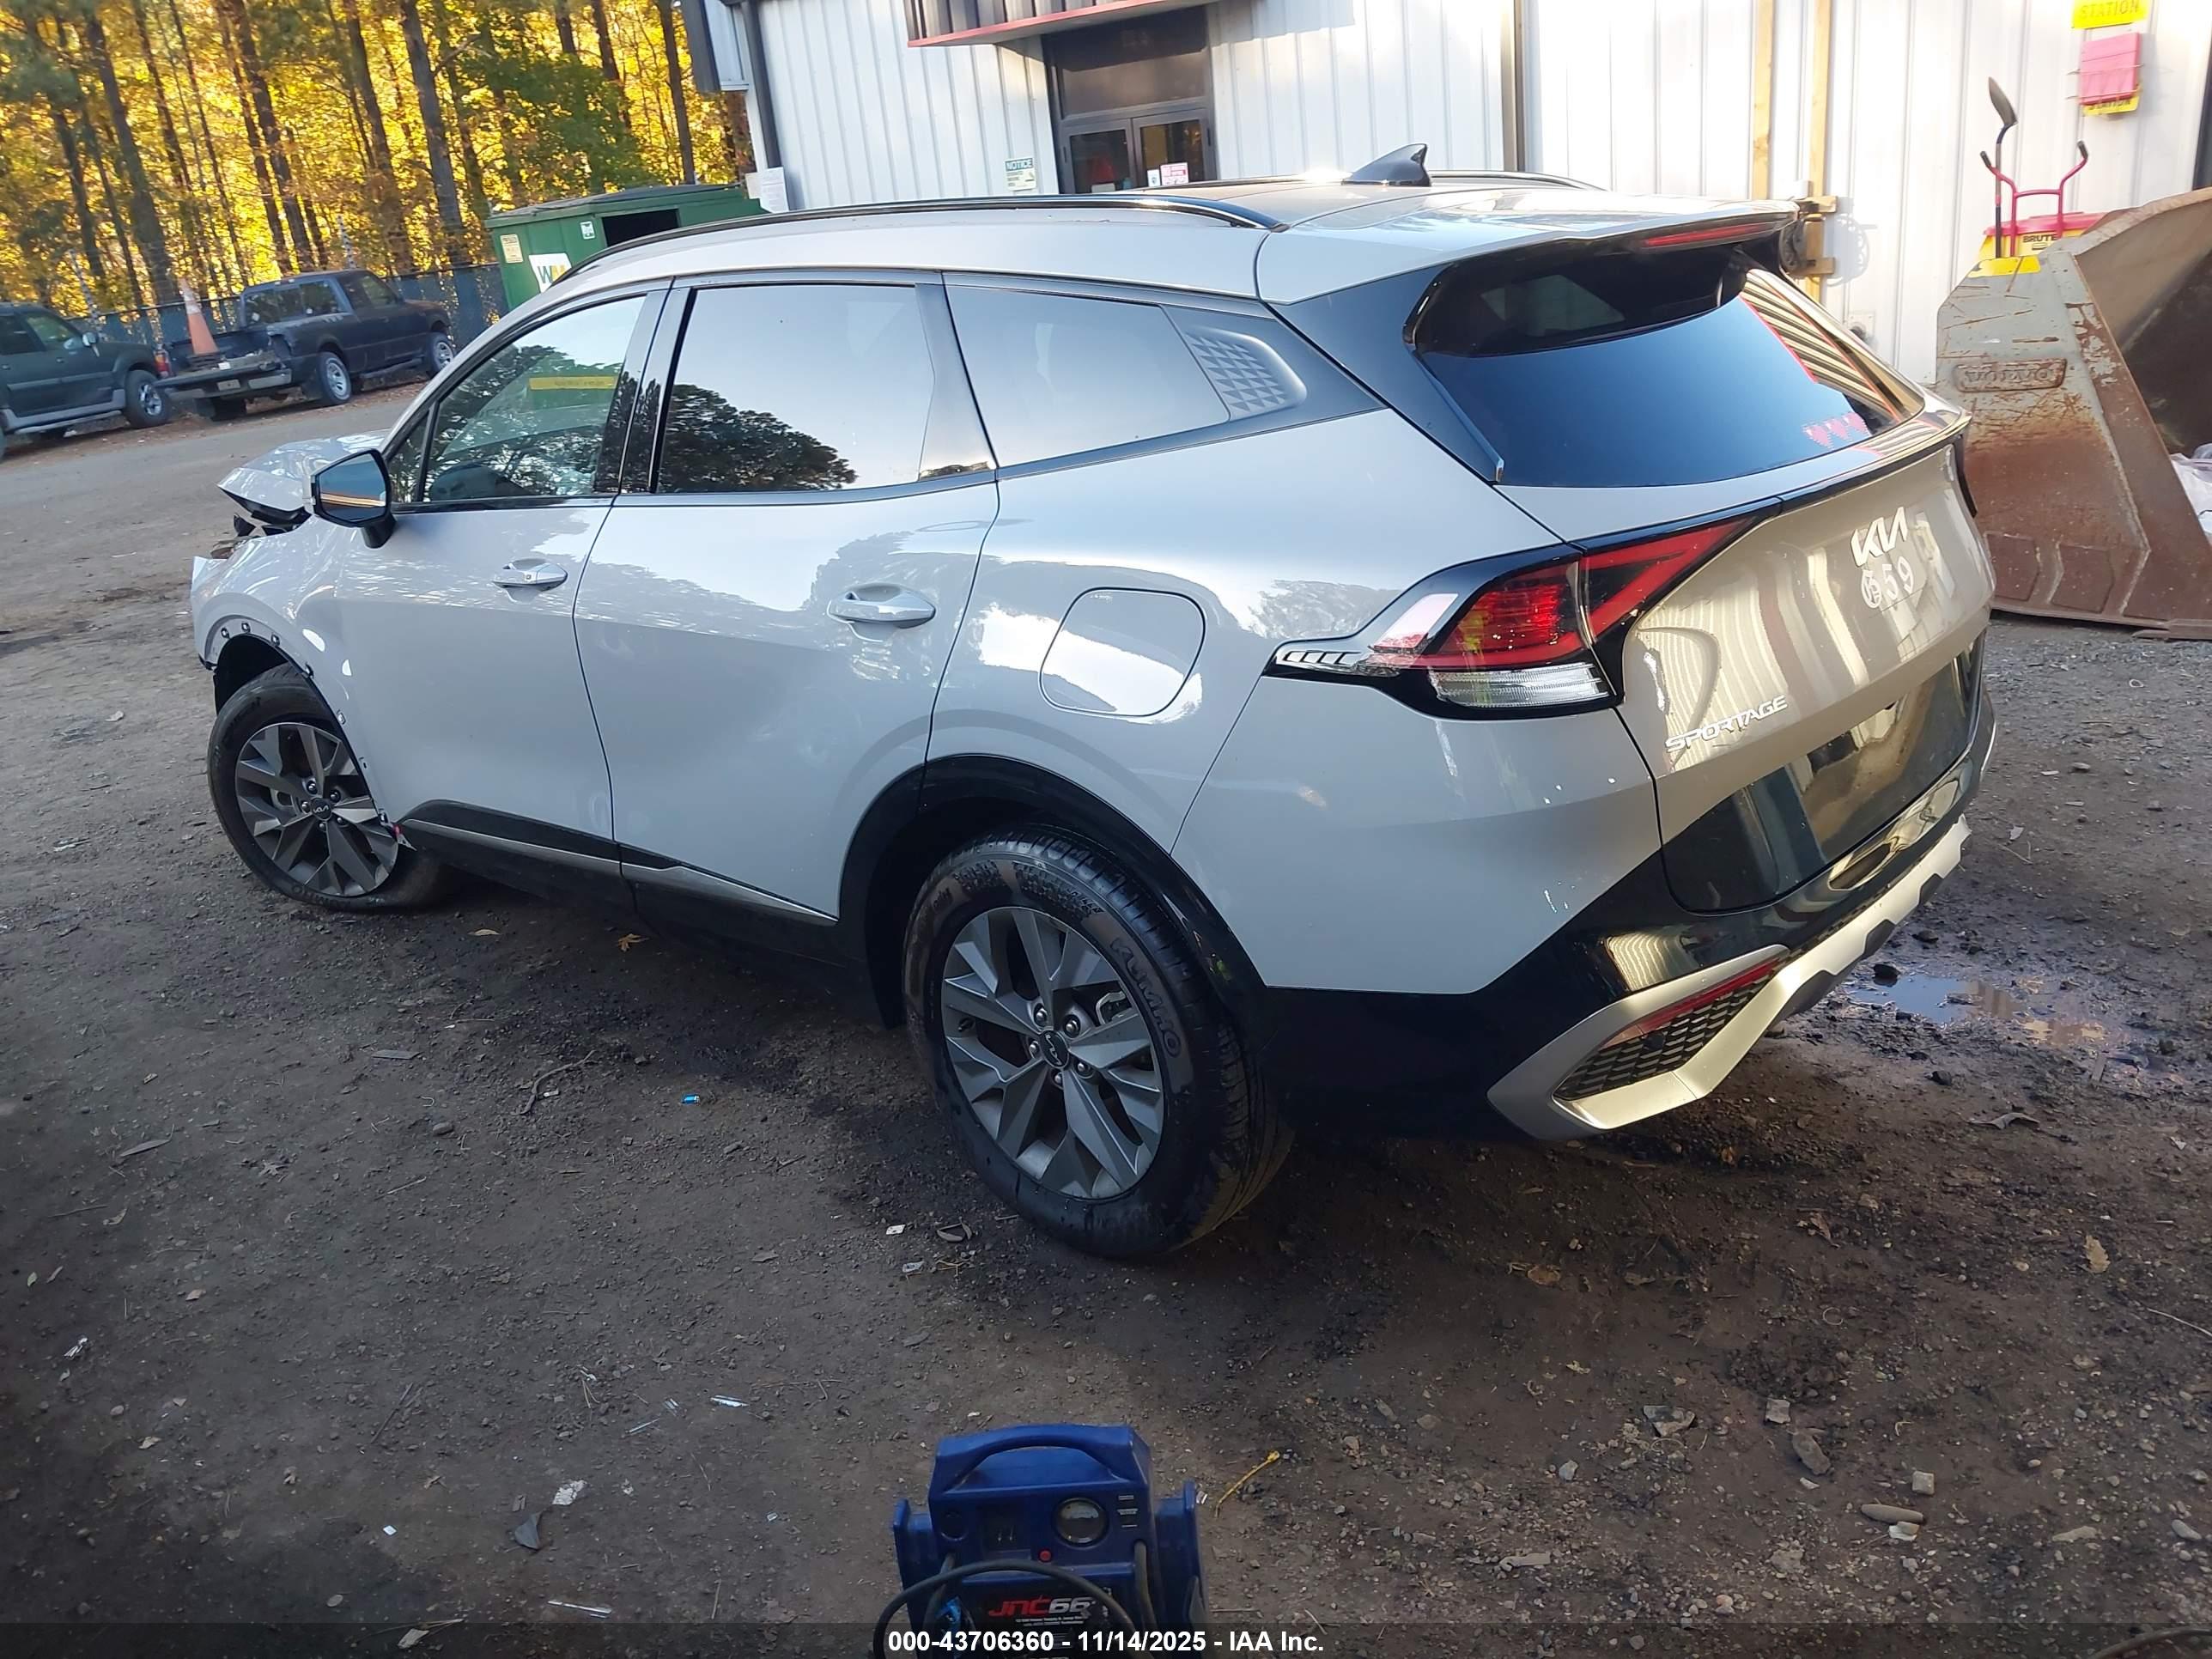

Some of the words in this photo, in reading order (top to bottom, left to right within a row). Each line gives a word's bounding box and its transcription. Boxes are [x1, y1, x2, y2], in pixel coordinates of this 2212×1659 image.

[1006, 158, 1033, 171] NOTICE
[2022, 234, 2058, 243] BRUTE
[537, 264, 566, 283] WM
[1850, 506, 1909, 568] KIA
[1664, 694, 1789, 754] SPORTAGE
